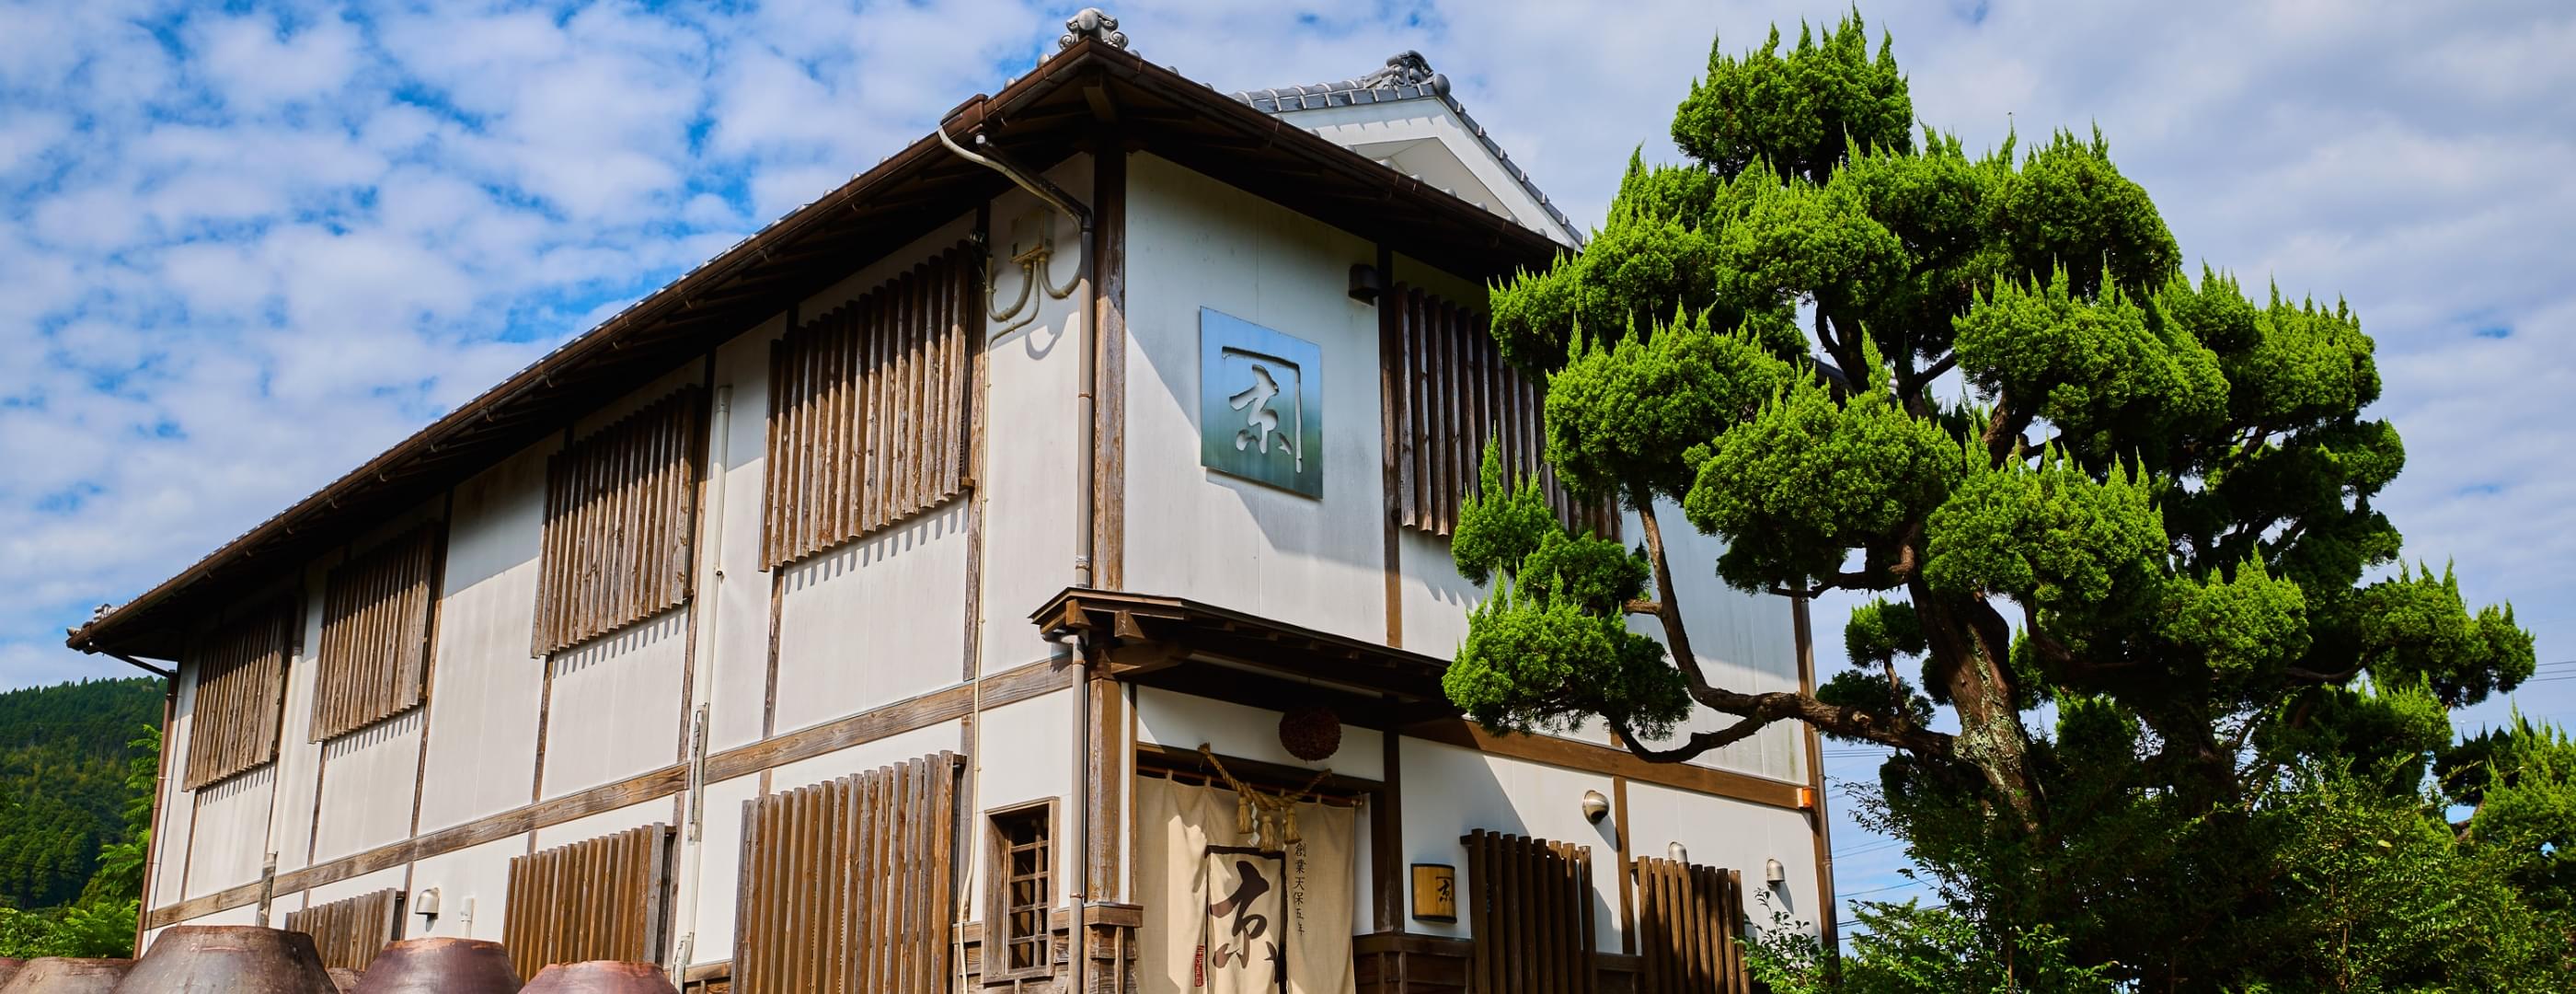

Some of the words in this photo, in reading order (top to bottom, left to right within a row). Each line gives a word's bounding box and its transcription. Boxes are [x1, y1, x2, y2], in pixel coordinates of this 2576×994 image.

[1294, 842, 1306, 936] 創業天保五年
